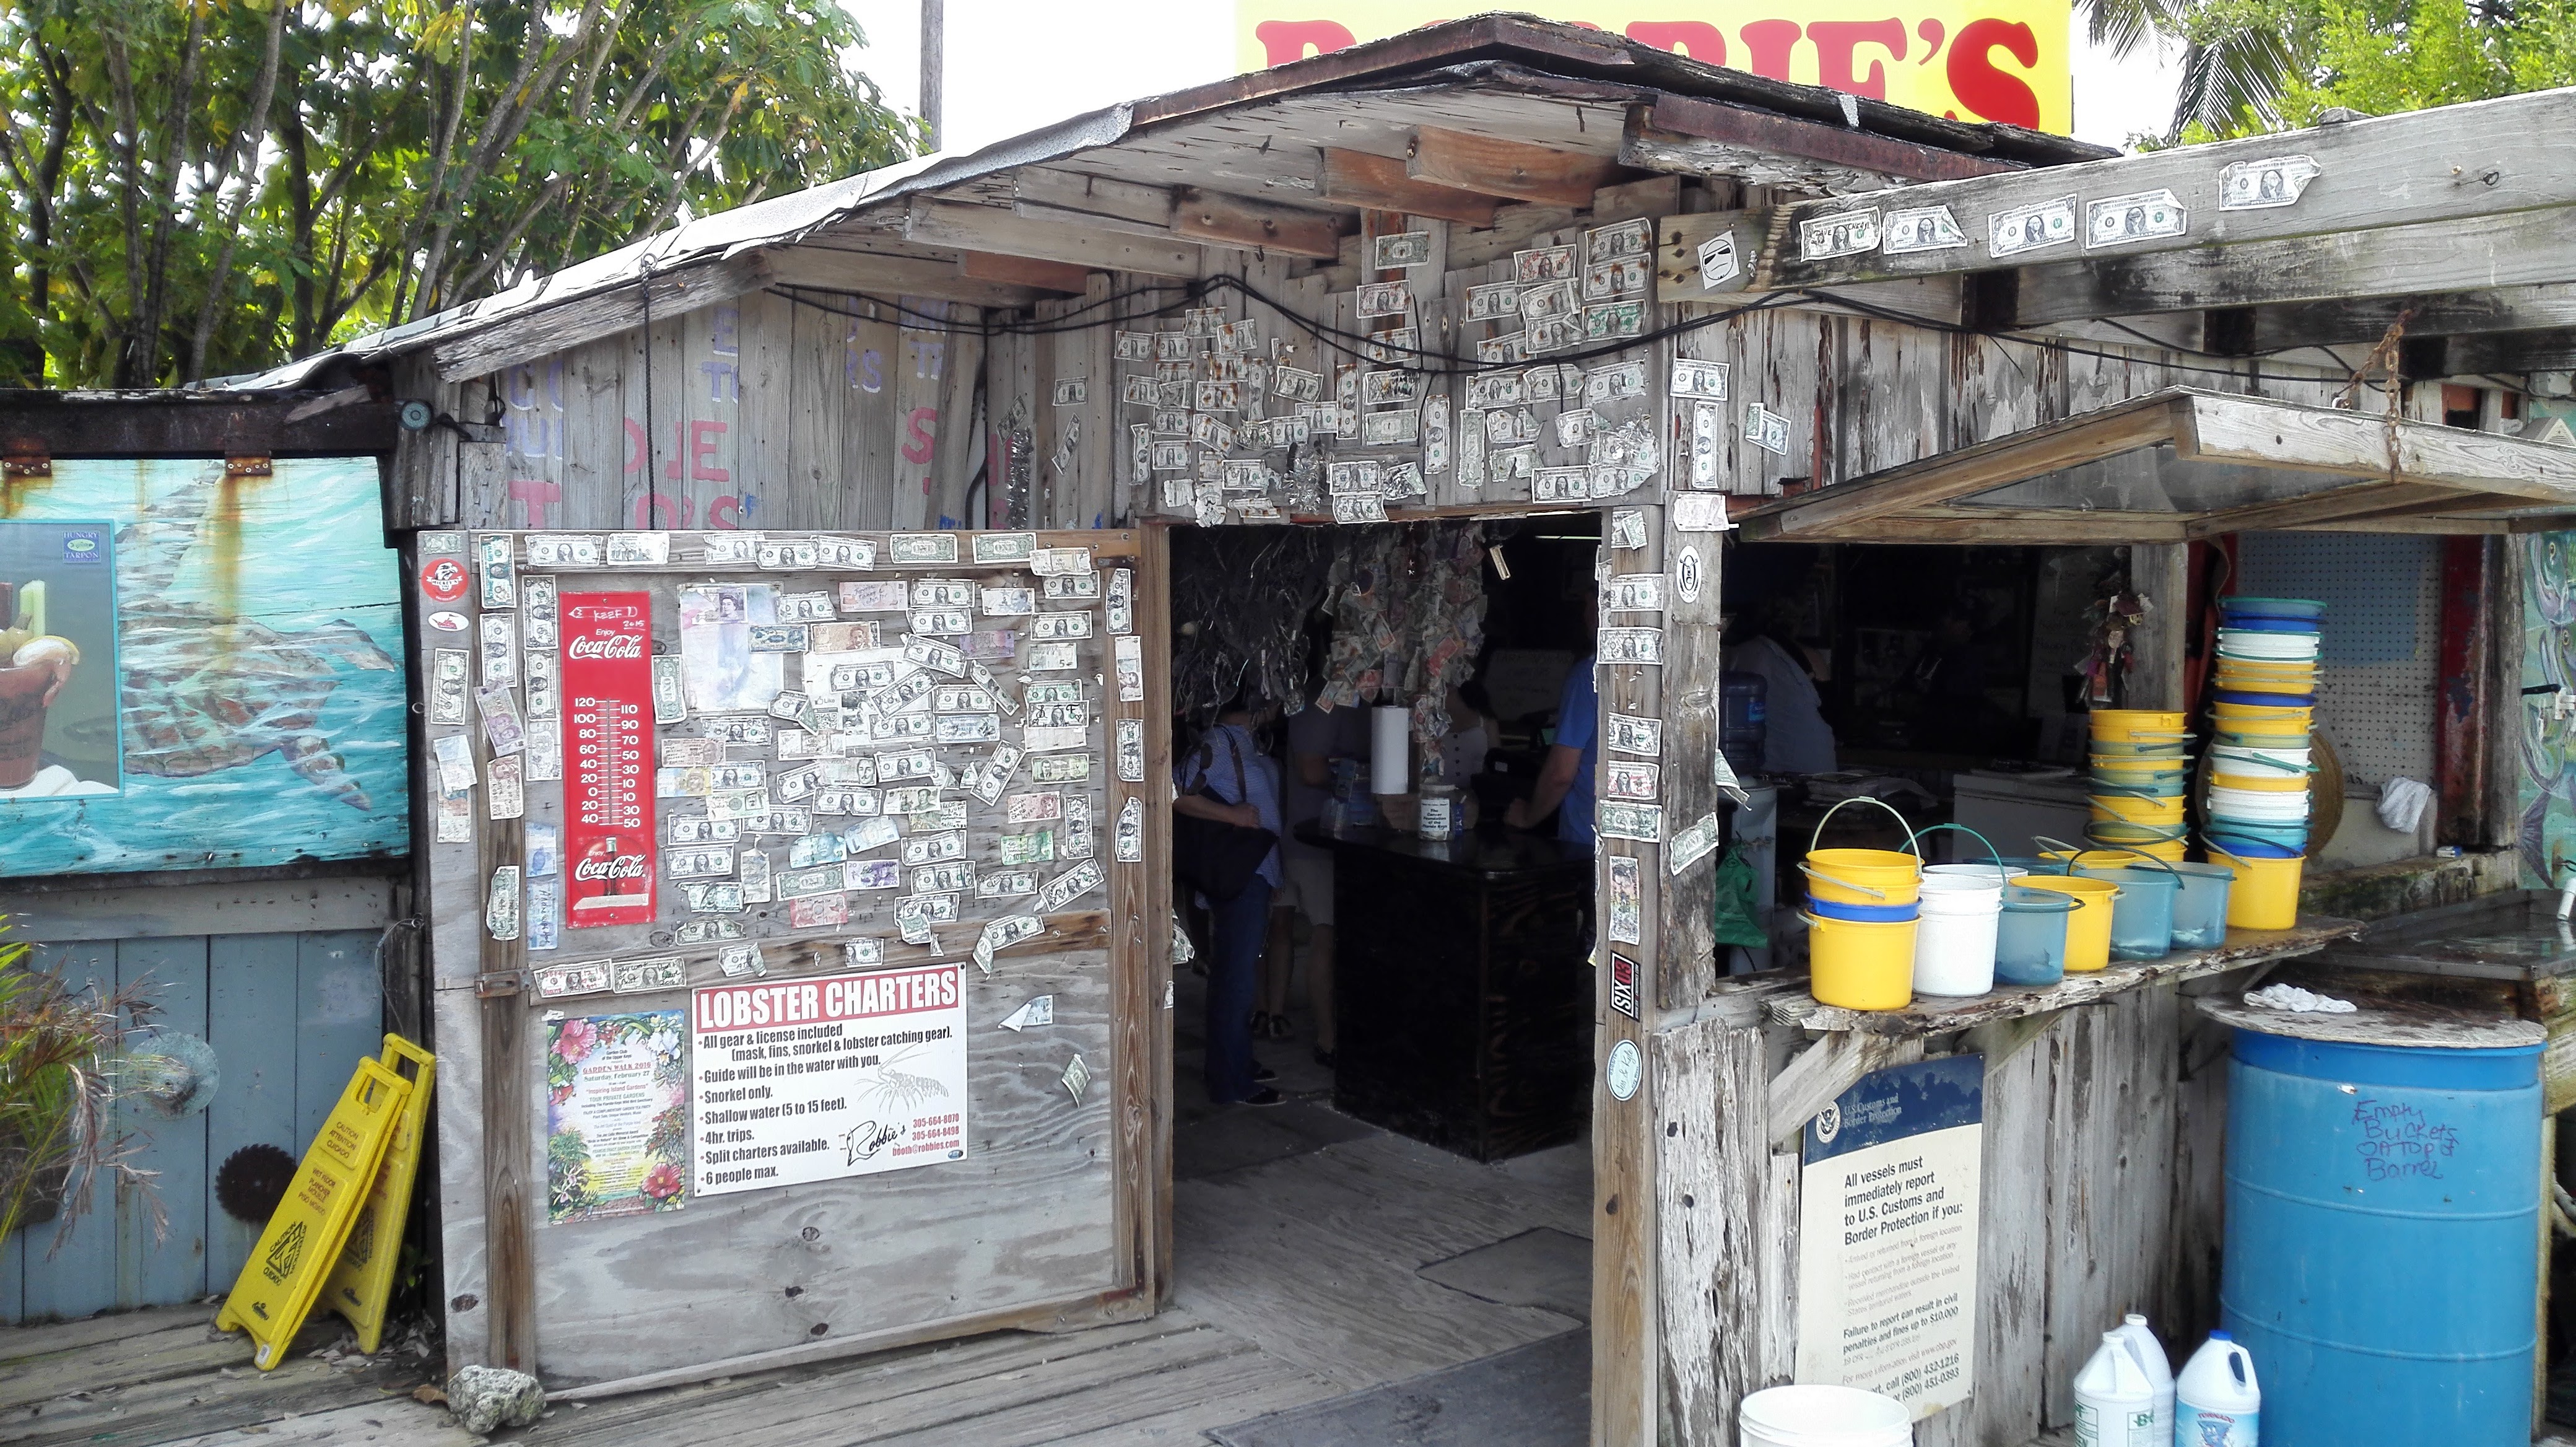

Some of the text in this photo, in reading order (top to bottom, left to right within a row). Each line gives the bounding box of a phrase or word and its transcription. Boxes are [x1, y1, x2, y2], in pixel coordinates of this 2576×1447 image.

[596, 628, 615, 636] Enjoy
[569, 635, 643, 659] Coca-Cola
[575, 697, 595, 707] 120
[621, 704, 638, 714] 110
[574, 714, 596, 723] 100
[621, 720, 638, 730] 90
[579, 729, 596, 738] 80
[622, 735, 638, 745] 70
[580, 745, 597, 754] 60
[622, 751, 639, 760] 50
[580, 759, 597, 769] 40
[622, 764, 639, 774] 30
[581, 774, 598, 783] 20
[623, 779, 635, 788] 10
[588, 787, 598, 797] 0
[623, 792, 635, 802] 10
[582, 801, 598, 810] 20
[623, 805, 640, 815] 30
[581, 814, 598, 823] 40
[624, 818, 640, 828] 50
[575, 854, 646, 881] Coca-Cola
[1614, 960, 1632, 1010] SIX03
[700, 970, 955, 1028] LOBSTER CHARTERS
[703, 1023, 842, 1049] All gear & license included
[731, 1028, 952, 1061] (mask, fins, snorkel & lobster catching gear).
[583, 1065, 611, 1073] GARDEN
[614, 1071, 640, 1080] February
[704, 1054, 881, 1083] Guide will be in the water with you.
[705, 1085, 772, 1103] Snorkel only.
[705, 1096, 846, 1124] Shallow water (5 to 15 feet).
[1858, 1099, 1885, 1114] Customs
[1886, 1093, 1899, 1104] and
[1844, 1106, 1902, 1127] Border Protection
[2352, 1099, 2426, 1129] Empty
[329, 1129, 357, 1150] ATTENTION
[336, 1121, 359, 1140] CAUTION
[705, 1129, 754, 1144] 4hr. trips.
[2364, 1118, 2460, 1145] Buckets
[327, 1140, 350, 1159] CUIDADO
[705, 1138, 829, 1165] Split charters available.
[892, 1139, 959, 1156] booth@robbies.com
[706, 1166, 778, 1185] 6 people max.
[1845, 1156, 1923, 1188] All vessels must
[1845, 1171, 1935, 1207] immediately report
[1845, 1187, 1944, 1226] to U.S. Customs and
[1845, 1203, 1963, 1245] Border Protection if you:
[270, 1221, 297, 1252] CAUTION
[1843, 1293, 1958, 1339] Failure to report can result in civil
[1843, 1336, 1877, 1355] penalties
[1879, 1330, 1892, 1342] and
[1893, 1324, 1909, 1336] fines
[1911, 1321, 1919, 1331] up
[1921, 1317, 1928, 1326] to
[1886, 1376, 1900, 1391] call
[1902, 1368, 1921, 1386] (800)
[1902, 1383, 1922, 1401] (800)
